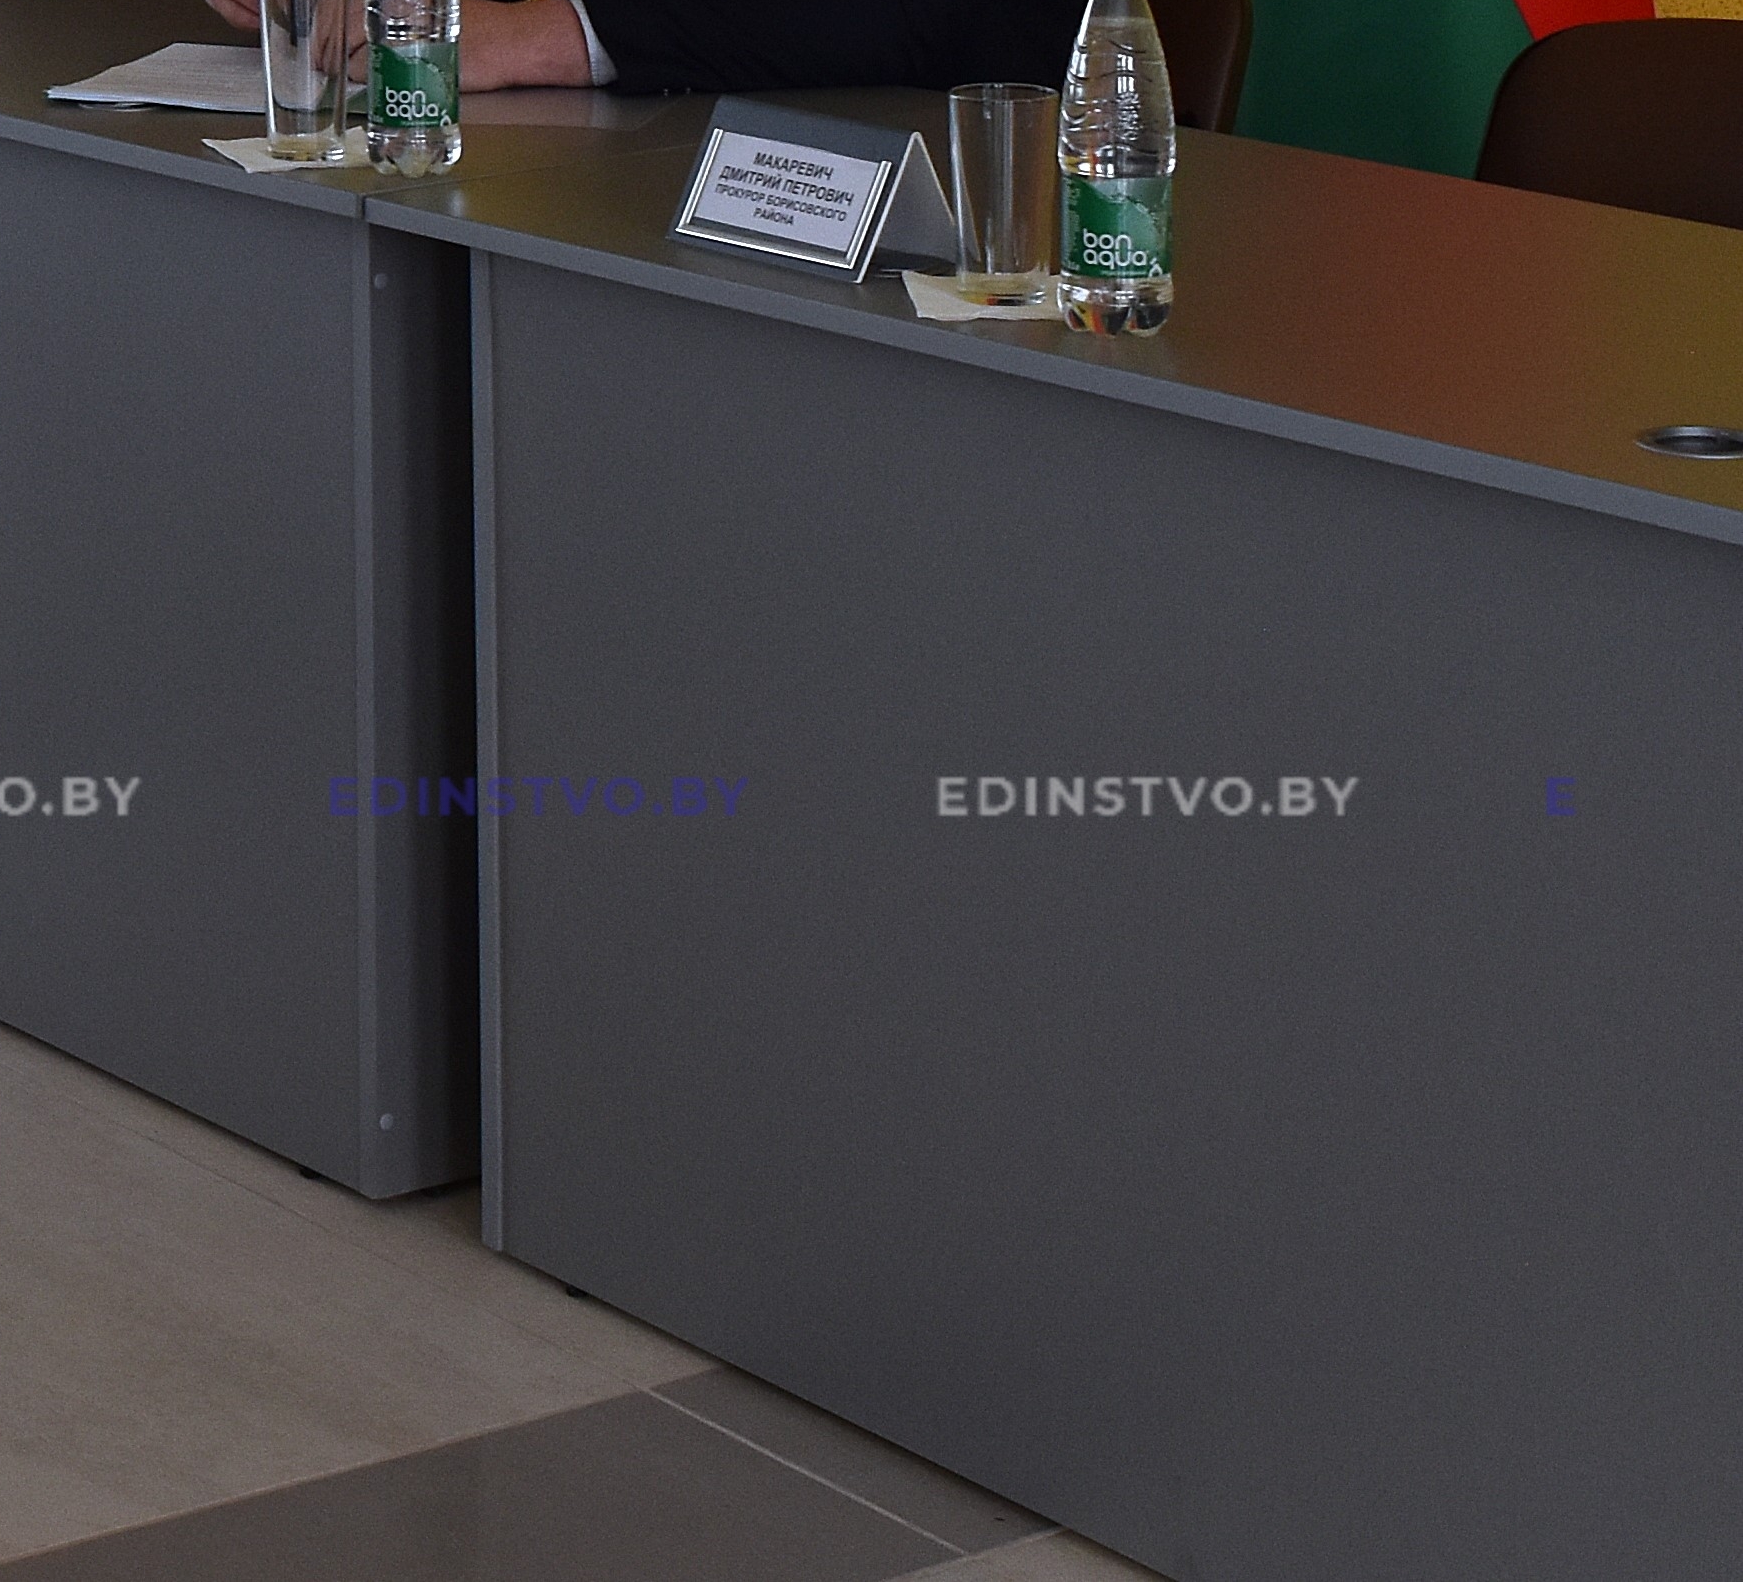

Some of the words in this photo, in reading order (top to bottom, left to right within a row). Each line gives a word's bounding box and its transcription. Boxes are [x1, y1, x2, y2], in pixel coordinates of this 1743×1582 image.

[385, 86, 426, 103] bon
[385, 103, 439, 121] aqua
[753, 151, 835, 181] МАКАРЕВИЧ
[718, 165, 782, 192] ДМИТРИЙ
[782, 178, 855, 206] ПЕТРОВИЧ
[715, 183, 766, 203] ПРОКУРОР
[765, 194, 848, 223] БОРИСОВСКОГО
[753, 206, 795, 227] РАЙОНА
[1083, 228, 1132, 250] bon
[1083, 249, 1148, 270] aqua
